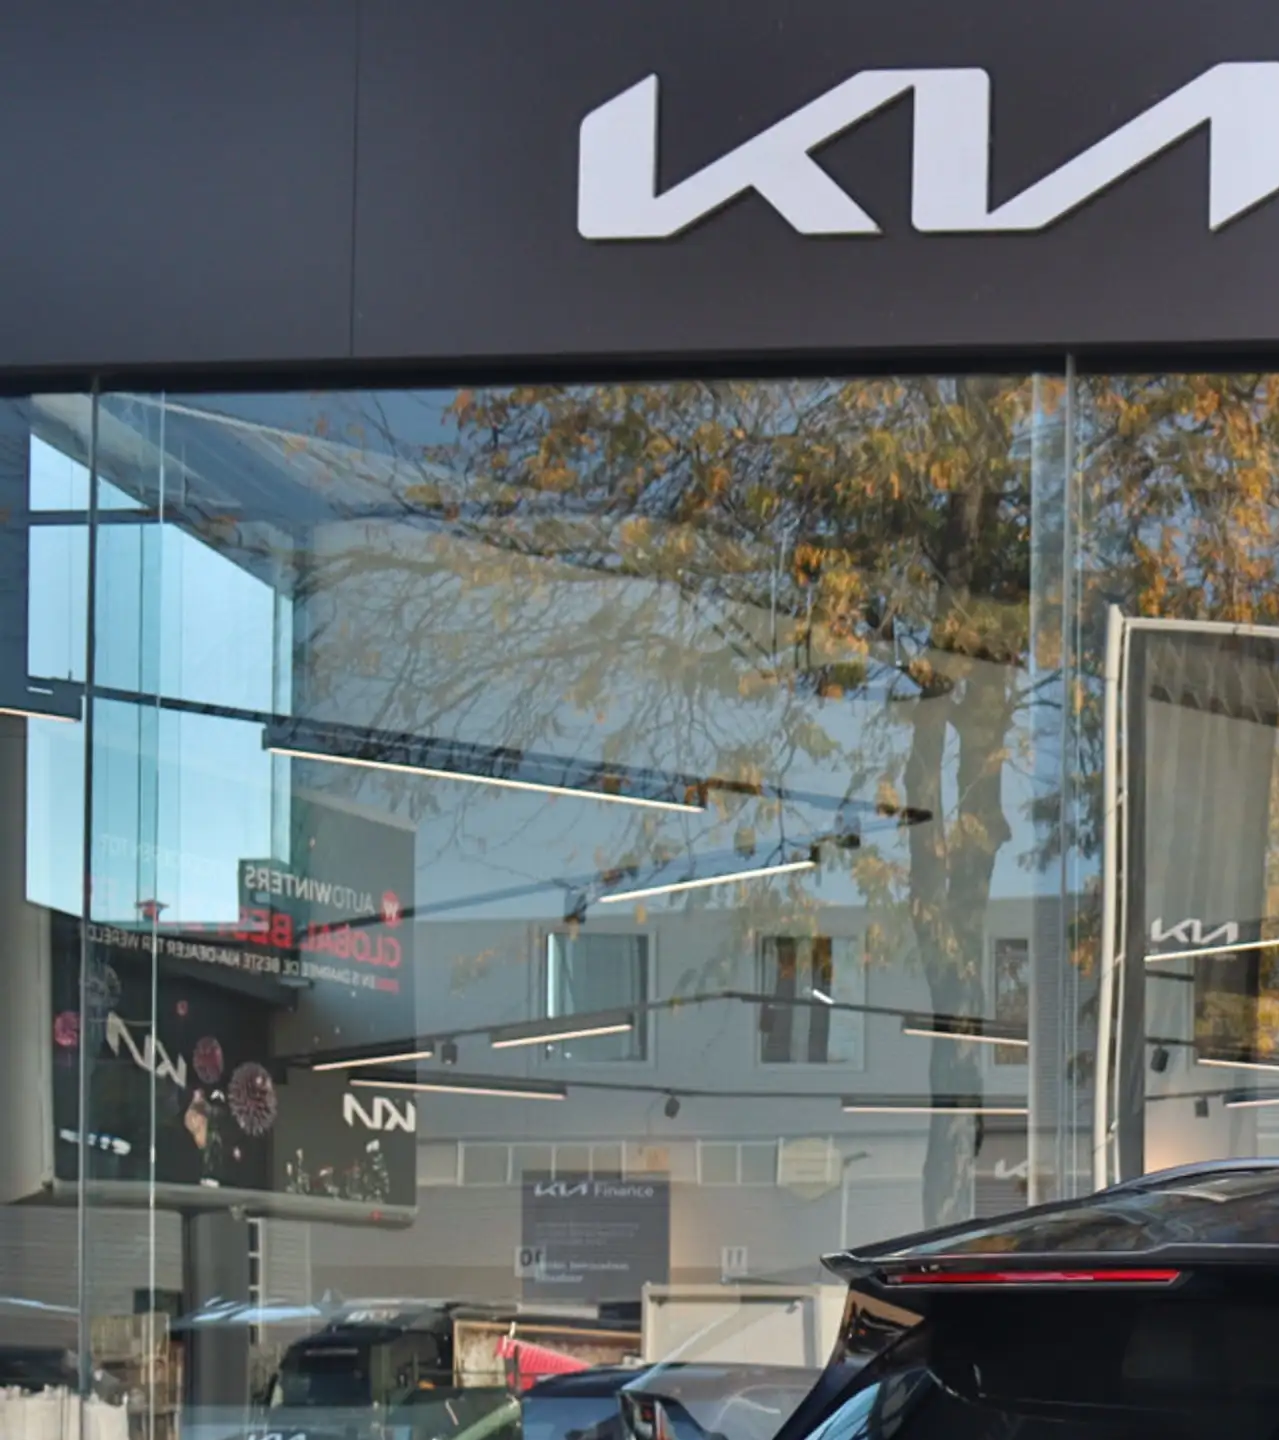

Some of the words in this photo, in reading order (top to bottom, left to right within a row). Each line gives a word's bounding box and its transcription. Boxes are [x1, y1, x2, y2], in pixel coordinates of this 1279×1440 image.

[1150, 916, 1239, 945] KIA
[534, 1182, 588, 1198] KIA
[593, 1182, 655, 1198] Finance
